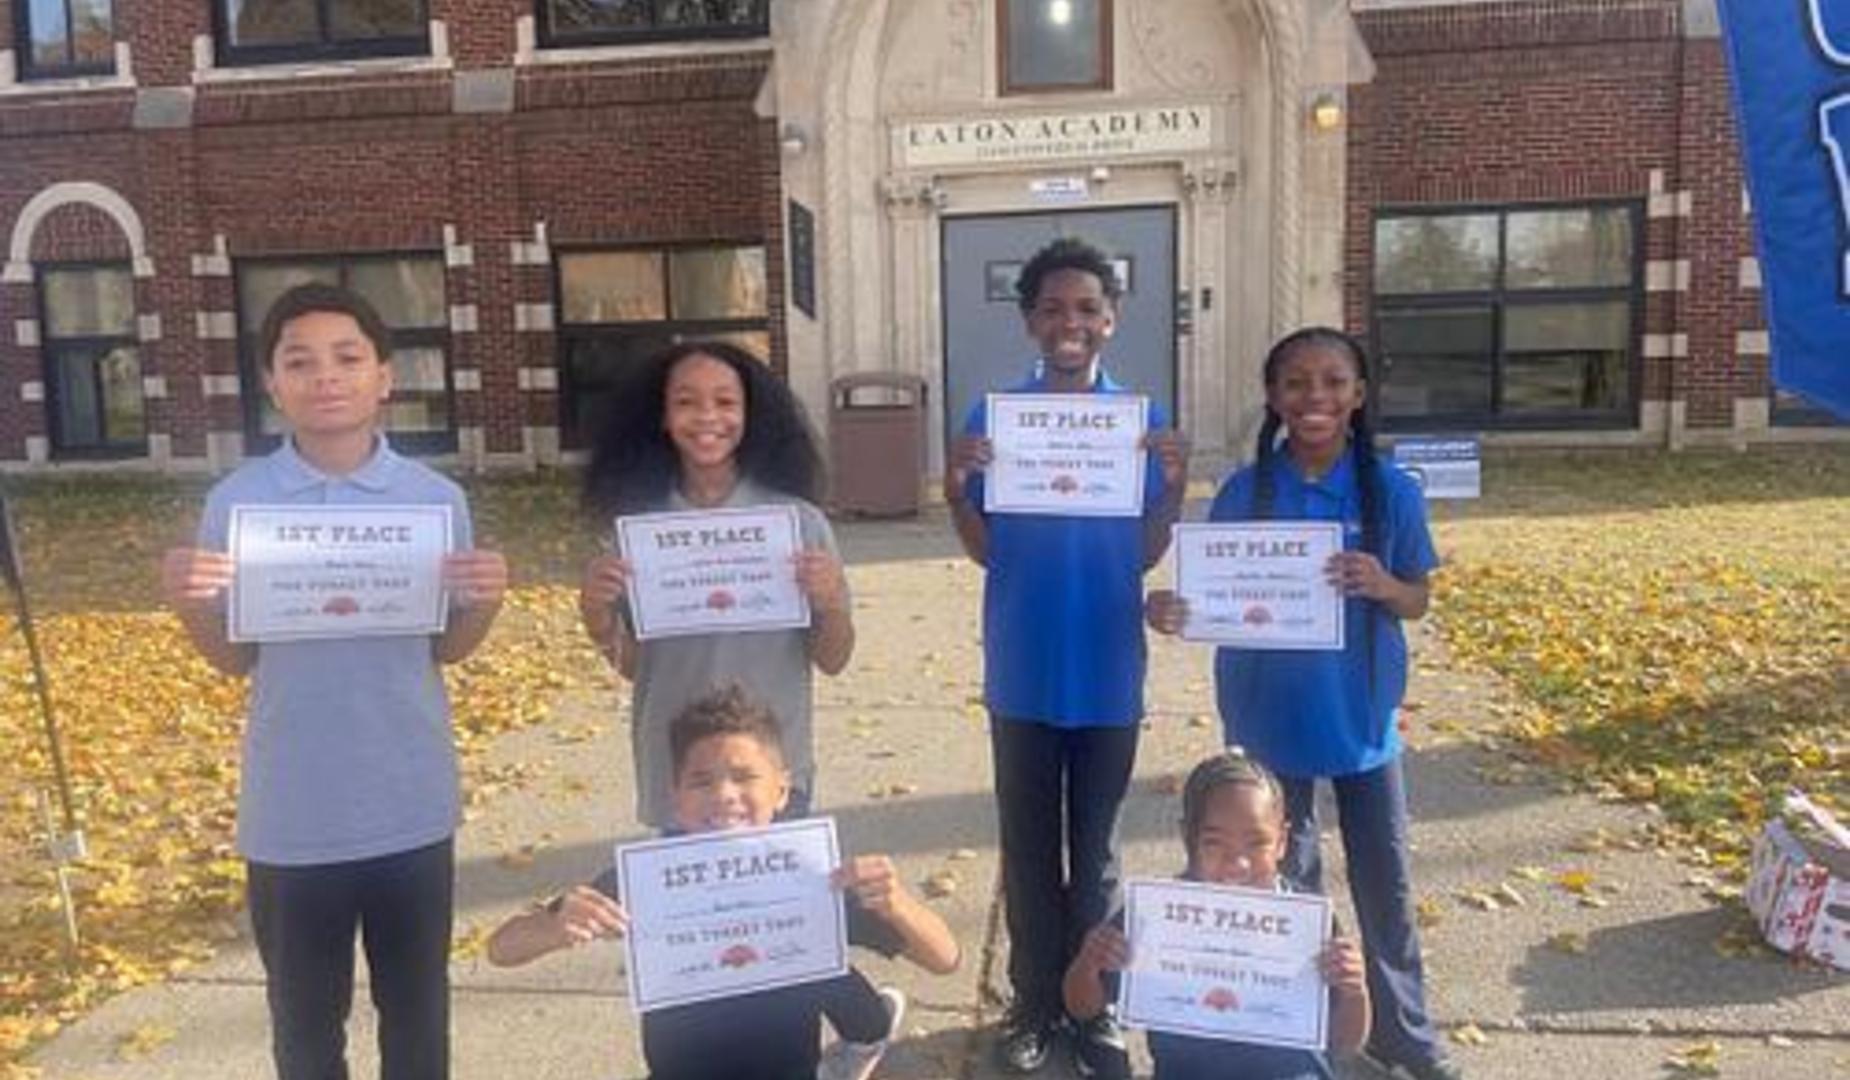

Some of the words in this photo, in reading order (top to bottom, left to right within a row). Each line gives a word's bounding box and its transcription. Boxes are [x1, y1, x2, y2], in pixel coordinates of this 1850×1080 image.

[908, 121, 1016, 146] EATON
[1036, 111, 1201, 139] ACADEMY
[1018, 412, 1050, 428] 1ST
[1056, 412, 1118, 429] PLACE
[277, 525, 322, 543] 1ST
[332, 525, 413, 543] PLACE
[655, 529, 692, 548] 1ST
[698, 526, 767, 549] PLACE
[1205, 541, 1239, 557] 1ST
[1247, 541, 1310, 557] PLACE
[663, 863, 708, 887] 1ST
[716, 851, 800, 880] PLACE
[1164, 903, 1206, 925] 1ST
[1213, 909, 1292, 935] PLACE
